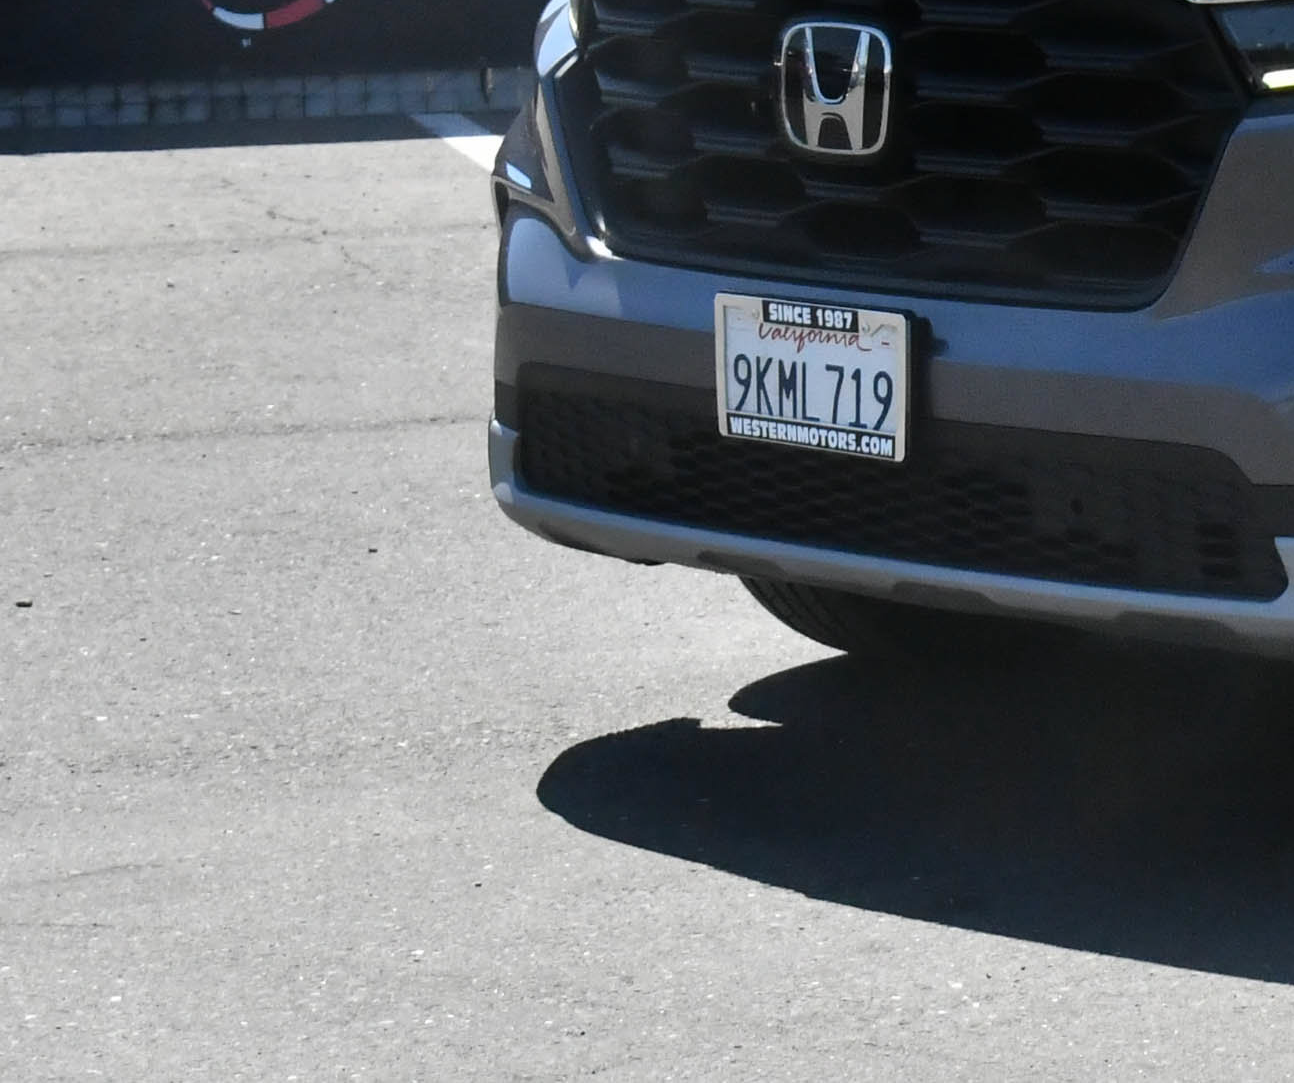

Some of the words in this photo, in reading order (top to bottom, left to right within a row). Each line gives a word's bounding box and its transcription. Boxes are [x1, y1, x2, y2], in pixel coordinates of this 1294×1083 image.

[768, 303, 811, 324] SINCE
[816, 308, 853, 329] 1987
[733, 353, 894, 431] 9KML719
[729, 416, 893, 457] WESTERNMOTORS.COM
